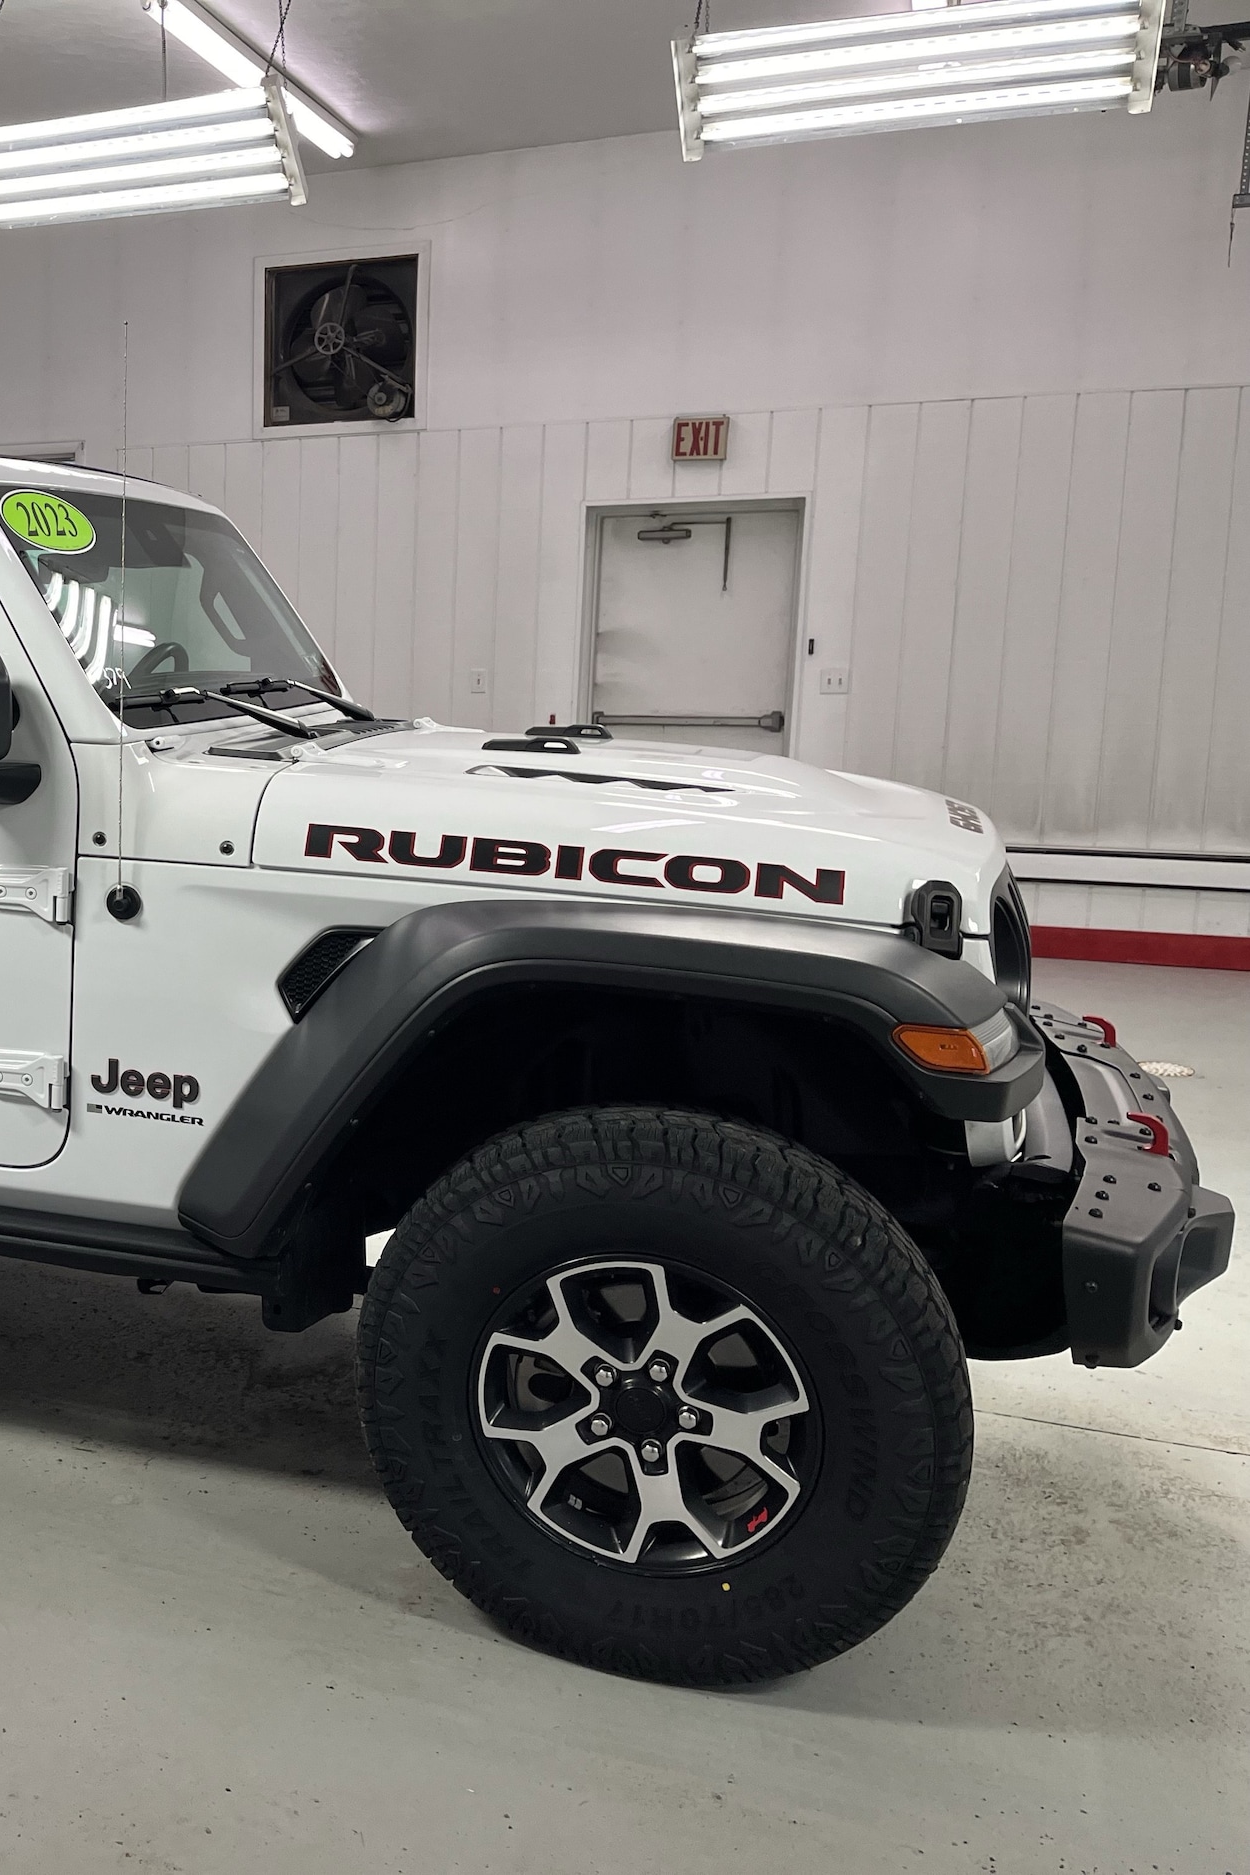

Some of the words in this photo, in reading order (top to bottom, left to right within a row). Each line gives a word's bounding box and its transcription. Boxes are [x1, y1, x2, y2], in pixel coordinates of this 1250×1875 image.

[674, 420, 725, 457] EXIT
[16, 501, 78, 538] 2023
[303, 823, 846, 905] RUBICON
[90, 1057, 200, 1109] Jeep
[103, 1105, 205, 1127] WRANGLER
